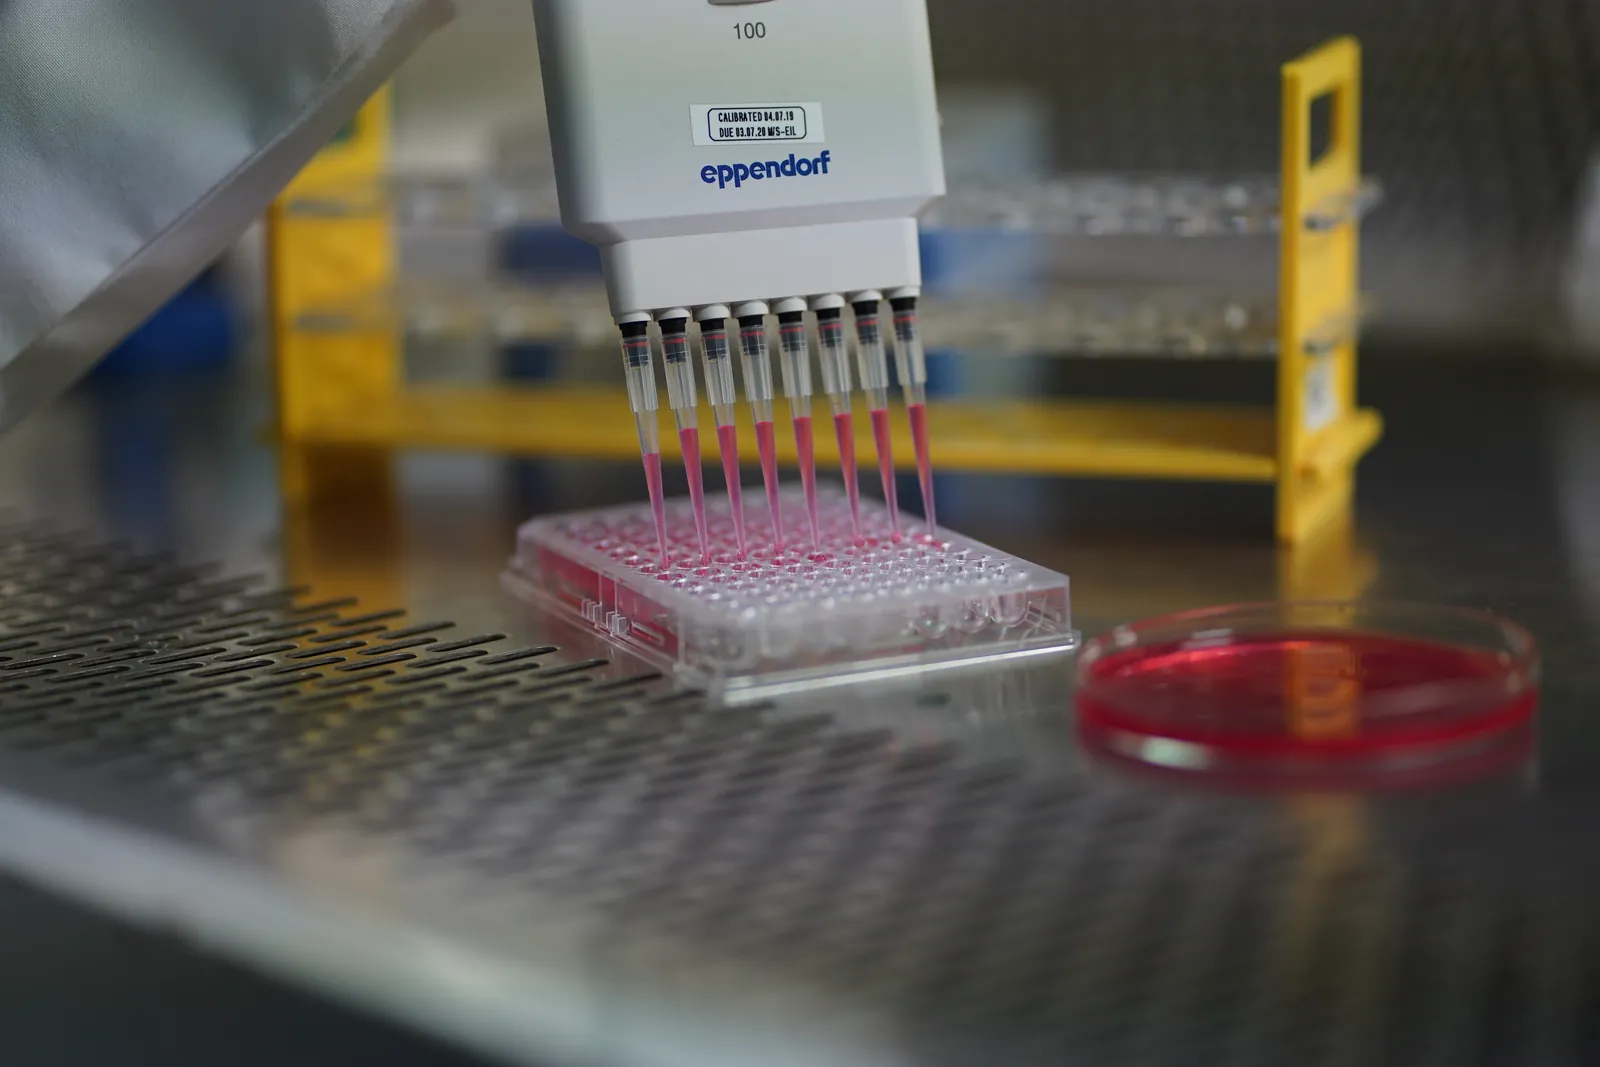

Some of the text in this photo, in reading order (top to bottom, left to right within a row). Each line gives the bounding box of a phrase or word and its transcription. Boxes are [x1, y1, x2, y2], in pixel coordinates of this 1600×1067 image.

[733, 21, 766, 40] 100
[718, 111, 794, 122] CALIBRATED 04.07.19
[719, 127, 734, 138] DUE
[735, 126, 766, 137] 03.07.20
[700, 150, 830, 189] eppendorf
